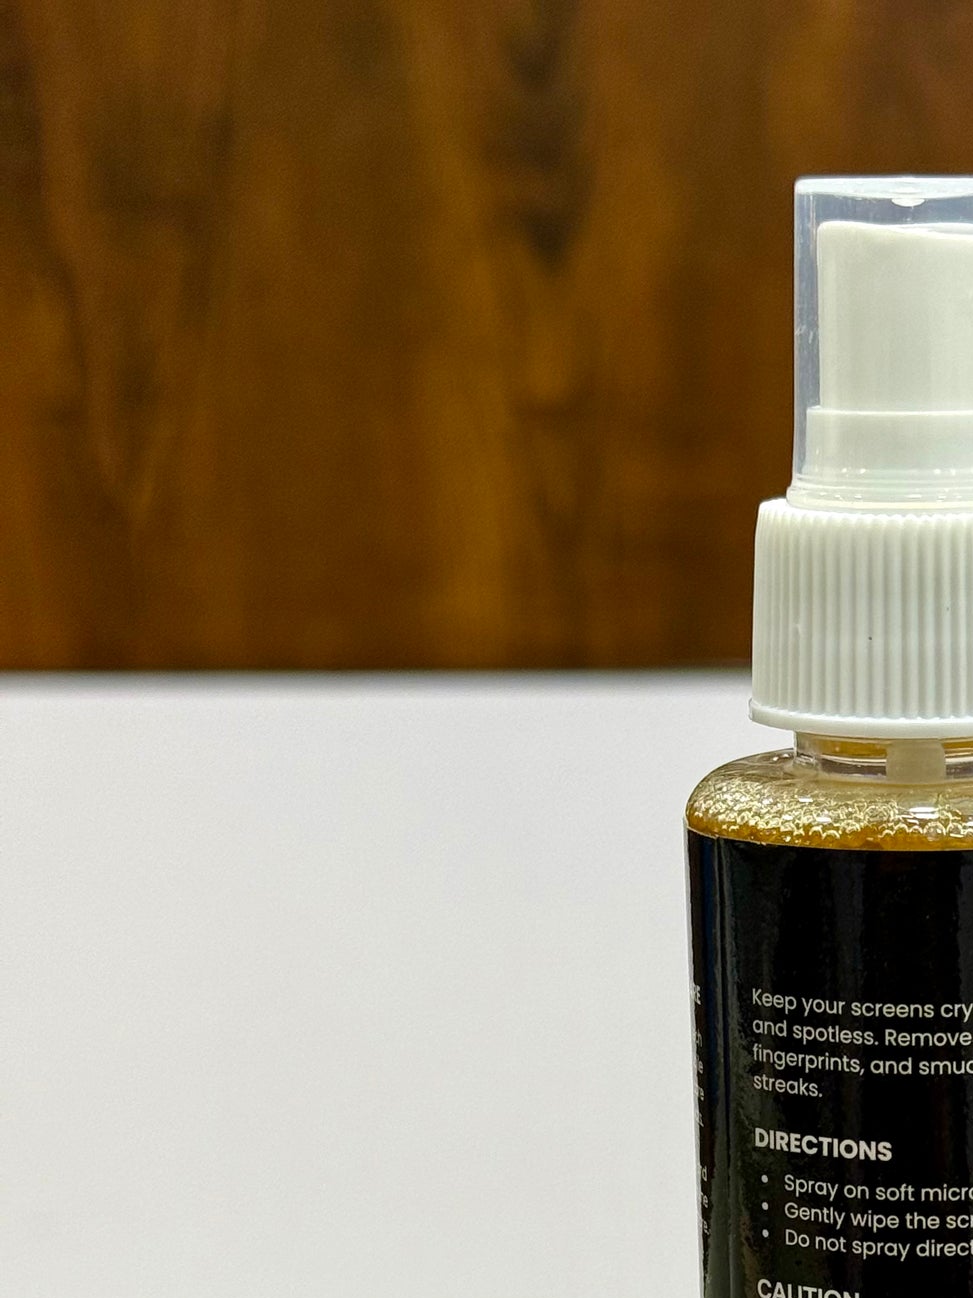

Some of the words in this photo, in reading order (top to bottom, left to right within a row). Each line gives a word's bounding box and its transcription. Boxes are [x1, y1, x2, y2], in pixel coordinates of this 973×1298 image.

[752, 987, 797, 1015] Keep
[801, 997, 846, 1017] your
[850, 1001, 935, 1019] screens
[752, 1019, 788, 1038] and
[792, 1024, 879, 1046] spotless.
[752, 1043, 865, 1076] fingerprints,
[869, 1056, 913, 1075] and
[753, 1074, 823, 1098] streaks.
[754, 1127, 893, 1162] DIRECTIONS
[784, 1174, 839, 1202] Spray
[843, 1184, 870, 1200] on
[875, 1182, 916, 1202] soft
[784, 1201, 846, 1230] Gently
[849, 1209, 900, 1233] wipe
[904, 1211, 941, 1230] the
[785, 1228, 810, 1248] Do
[815, 1235, 847, 1253] not
[851, 1240, 911, 1262] spray
